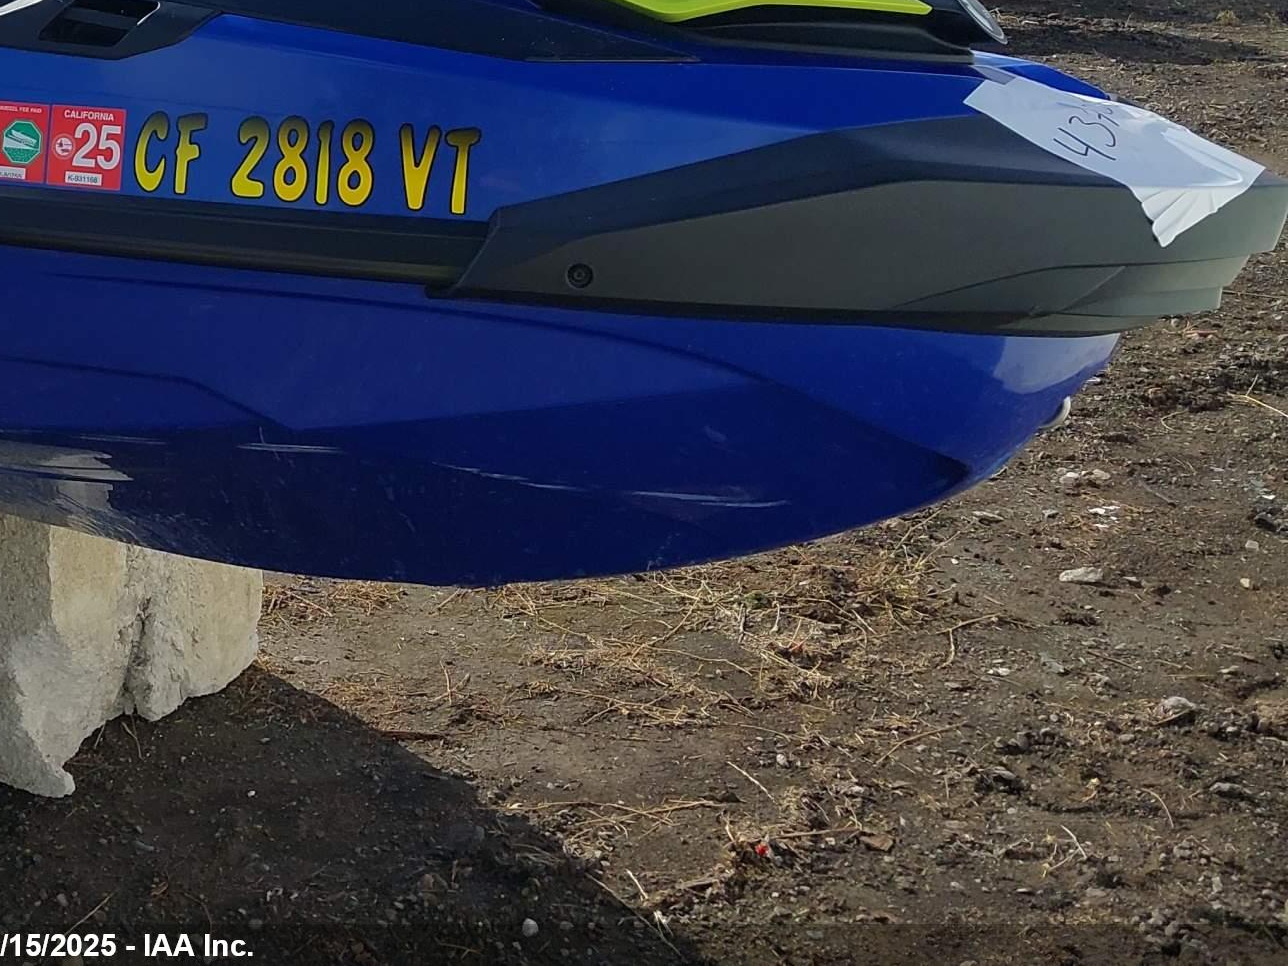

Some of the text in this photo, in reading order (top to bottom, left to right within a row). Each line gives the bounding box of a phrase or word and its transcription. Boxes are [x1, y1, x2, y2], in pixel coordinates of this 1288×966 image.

[64, 109, 115, 122] CALIFORNIA
[71, 122, 122, 170] 25
[134, 111, 482, 215] CF 2818 VT
